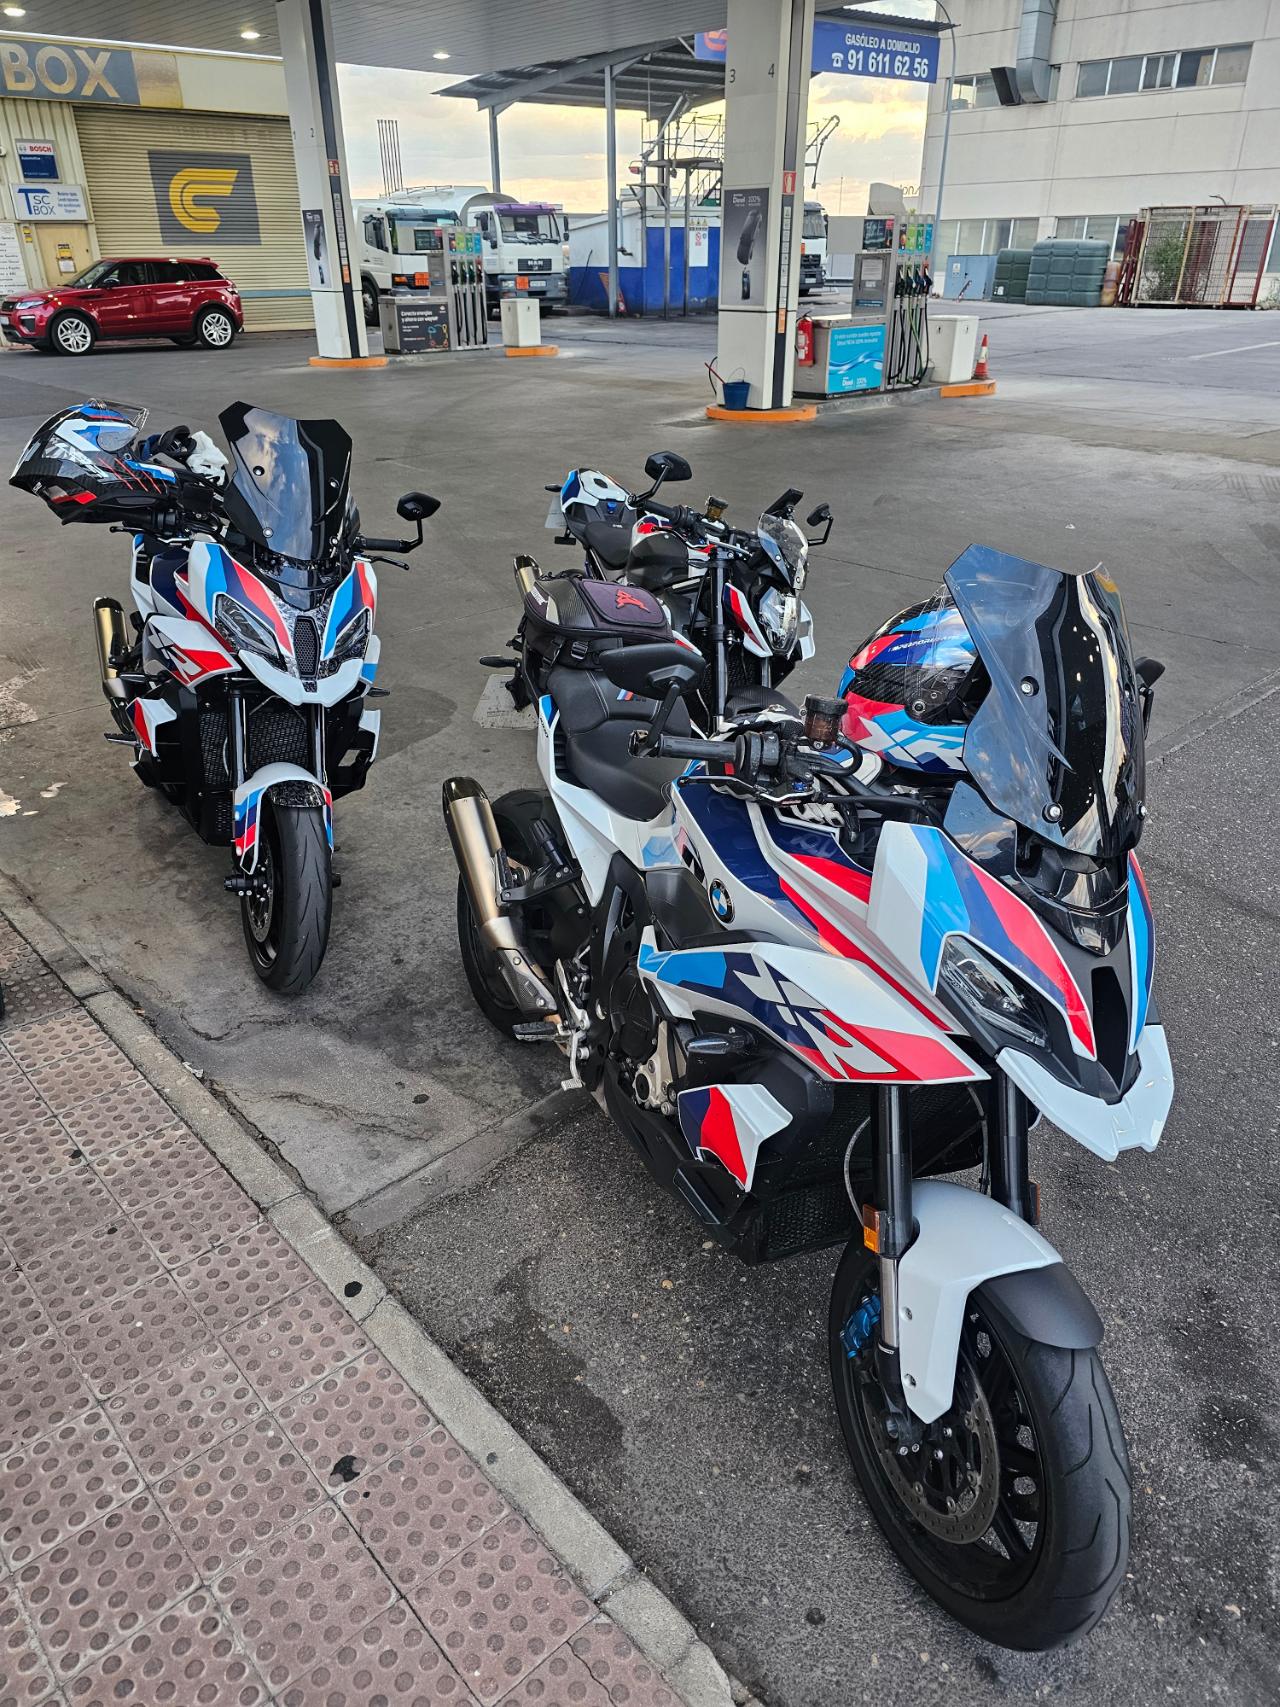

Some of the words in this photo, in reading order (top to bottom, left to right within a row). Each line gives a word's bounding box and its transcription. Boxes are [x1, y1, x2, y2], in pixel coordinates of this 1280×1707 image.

[845, 33, 879, 49] GASÓLEO
[880, 39, 886, 50] A
[887, 39, 920, 55] DOMICILIO
[0, 42, 120, 97] BOX
[768, 63, 775, 78] 4
[847, 49, 864, 71] 91
[868, 51, 890, 74] 611
[894, 55, 910, 76] 62
[913, 58, 929, 79] 56
[729, 68, 736, 83] 3
[29, 145, 52, 153] BOSCH
[33, 205, 57, 216] BOX
[732, 953, 899, 1080] XR
